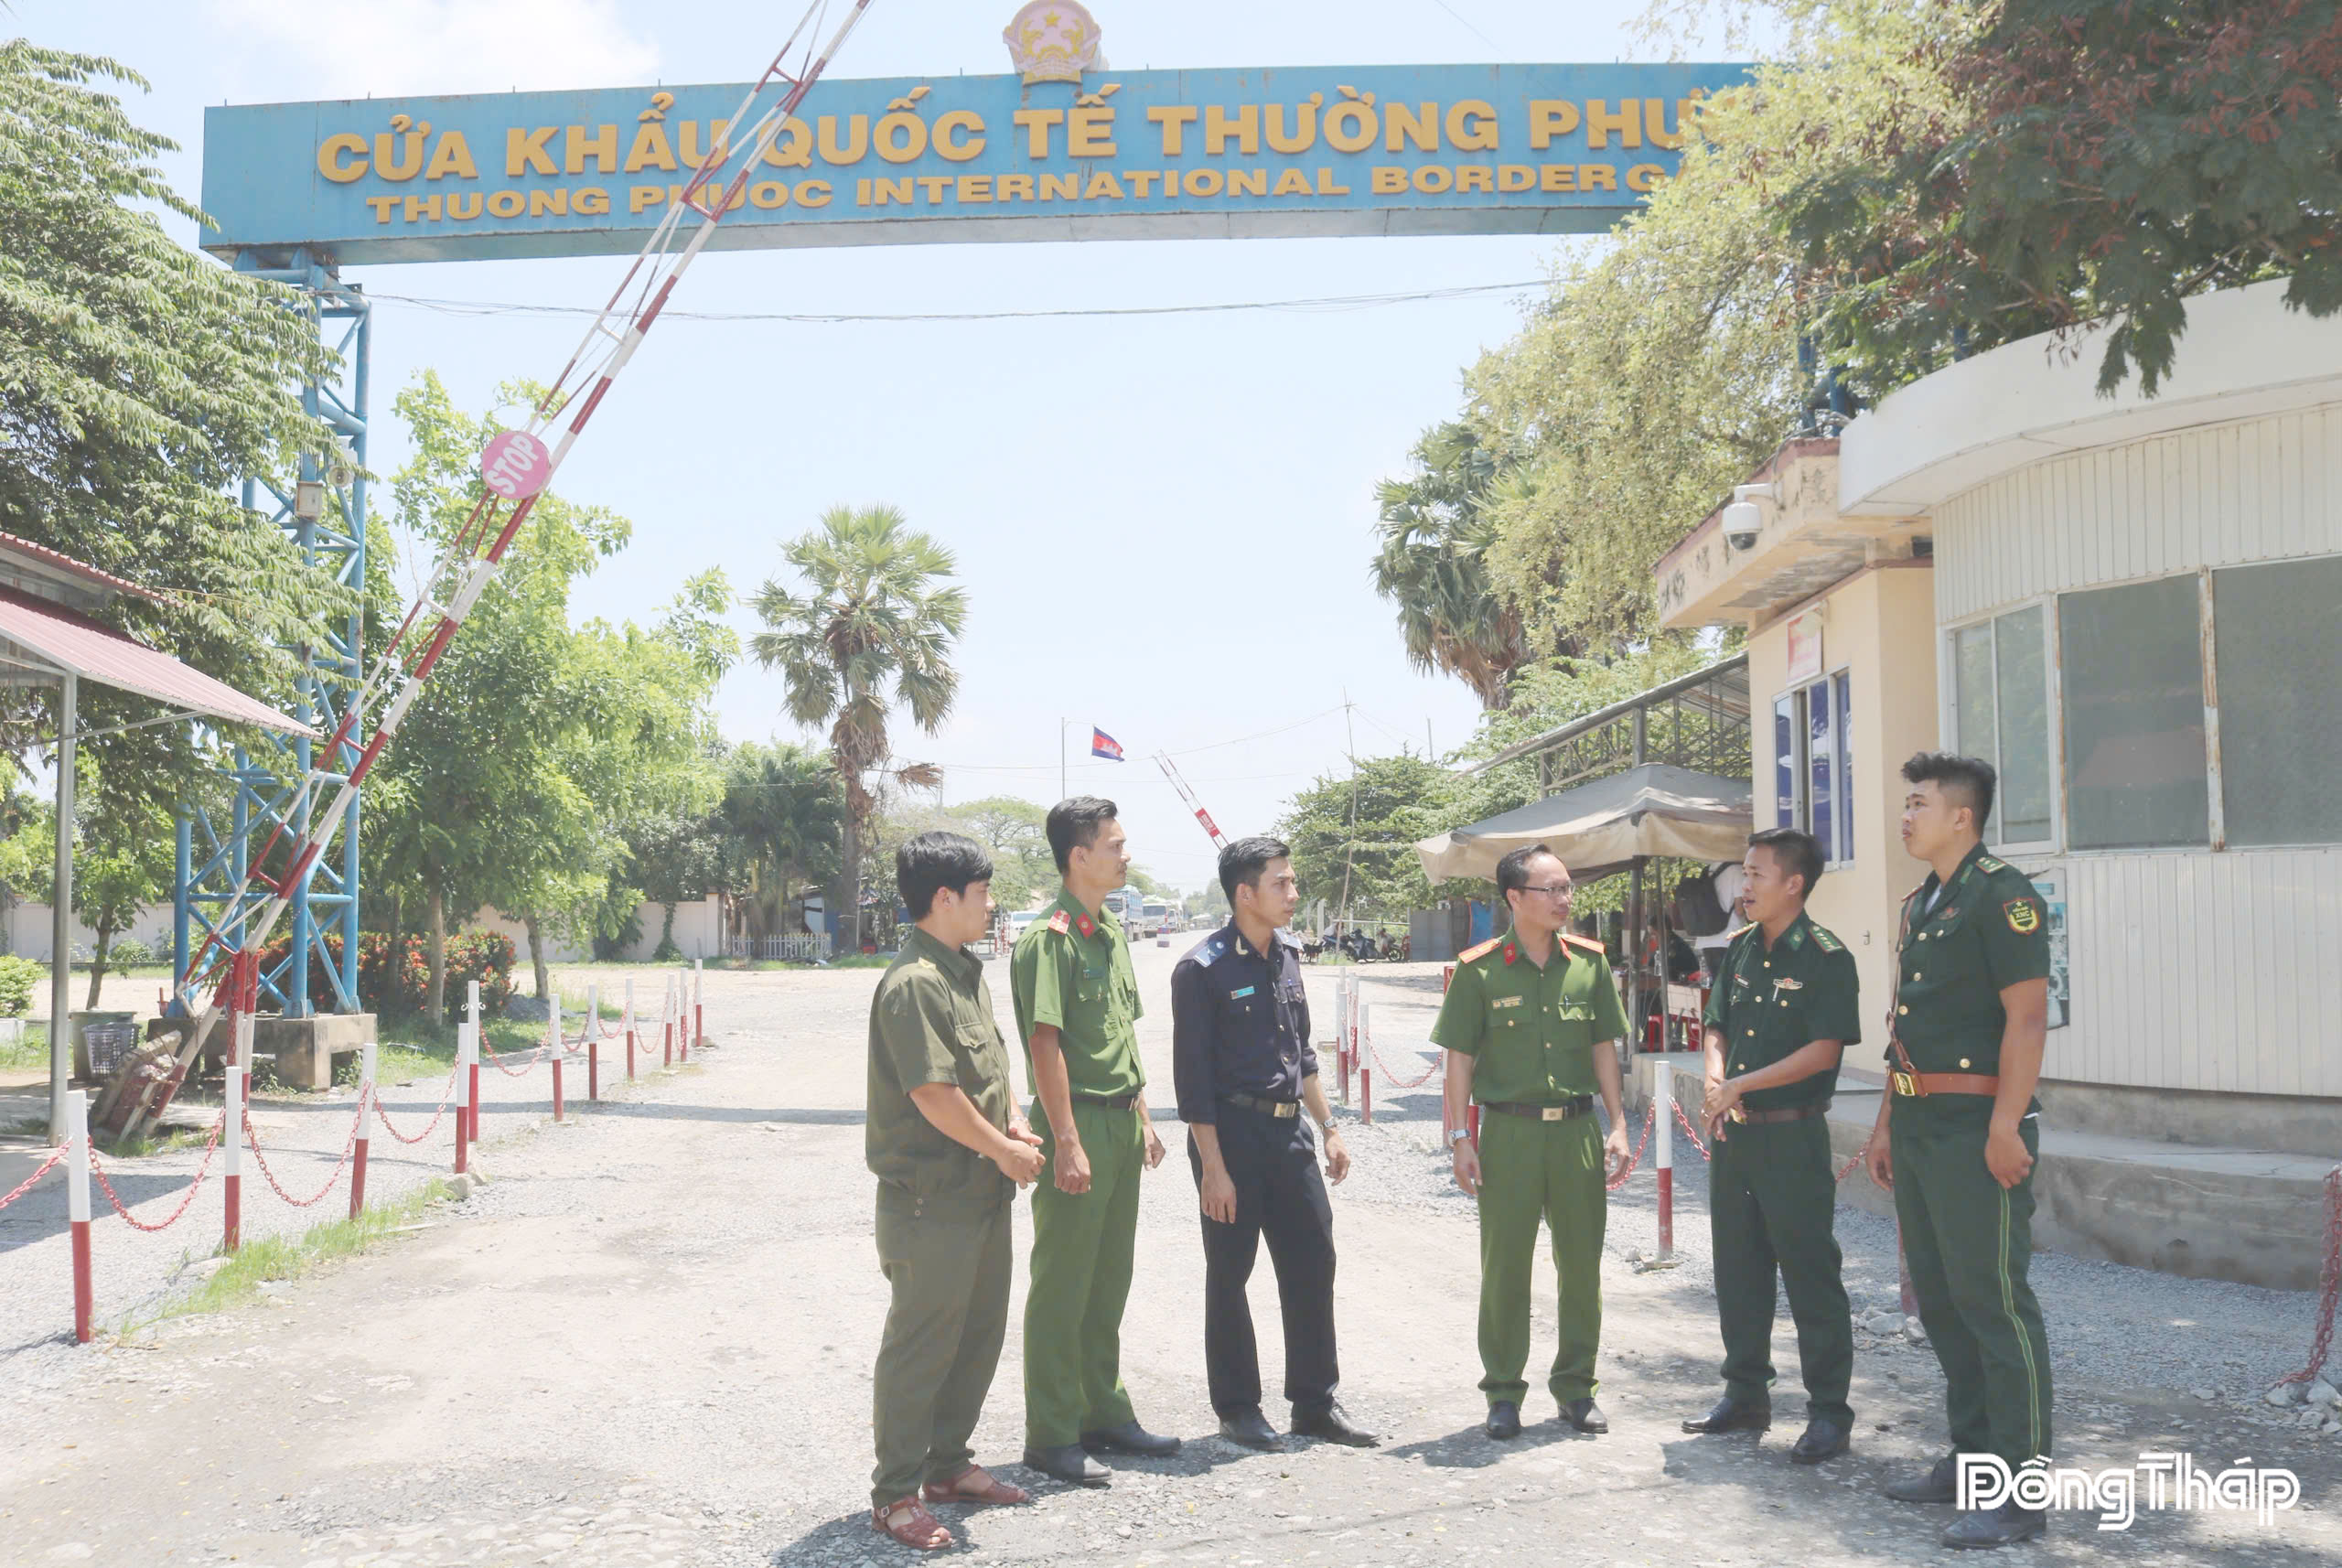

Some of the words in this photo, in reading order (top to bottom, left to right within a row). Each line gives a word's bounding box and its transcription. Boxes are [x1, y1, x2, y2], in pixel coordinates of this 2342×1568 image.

[317, 113, 478, 183] CỬA
[505, 91, 729, 177] KHẨU
[756, 86, 986, 168] QUỐC
[1013, 82, 1122, 159] TẾ
[1147, 85, 1499, 156] THƯỜNG
[1529, 87, 1713, 150] PHƯ
[366, 186, 610, 223] THUONG
[628, 179, 833, 214] PHUOC
[856, 166, 1351, 207] INTERNATIONAL
[486, 435, 538, 494] STOP
